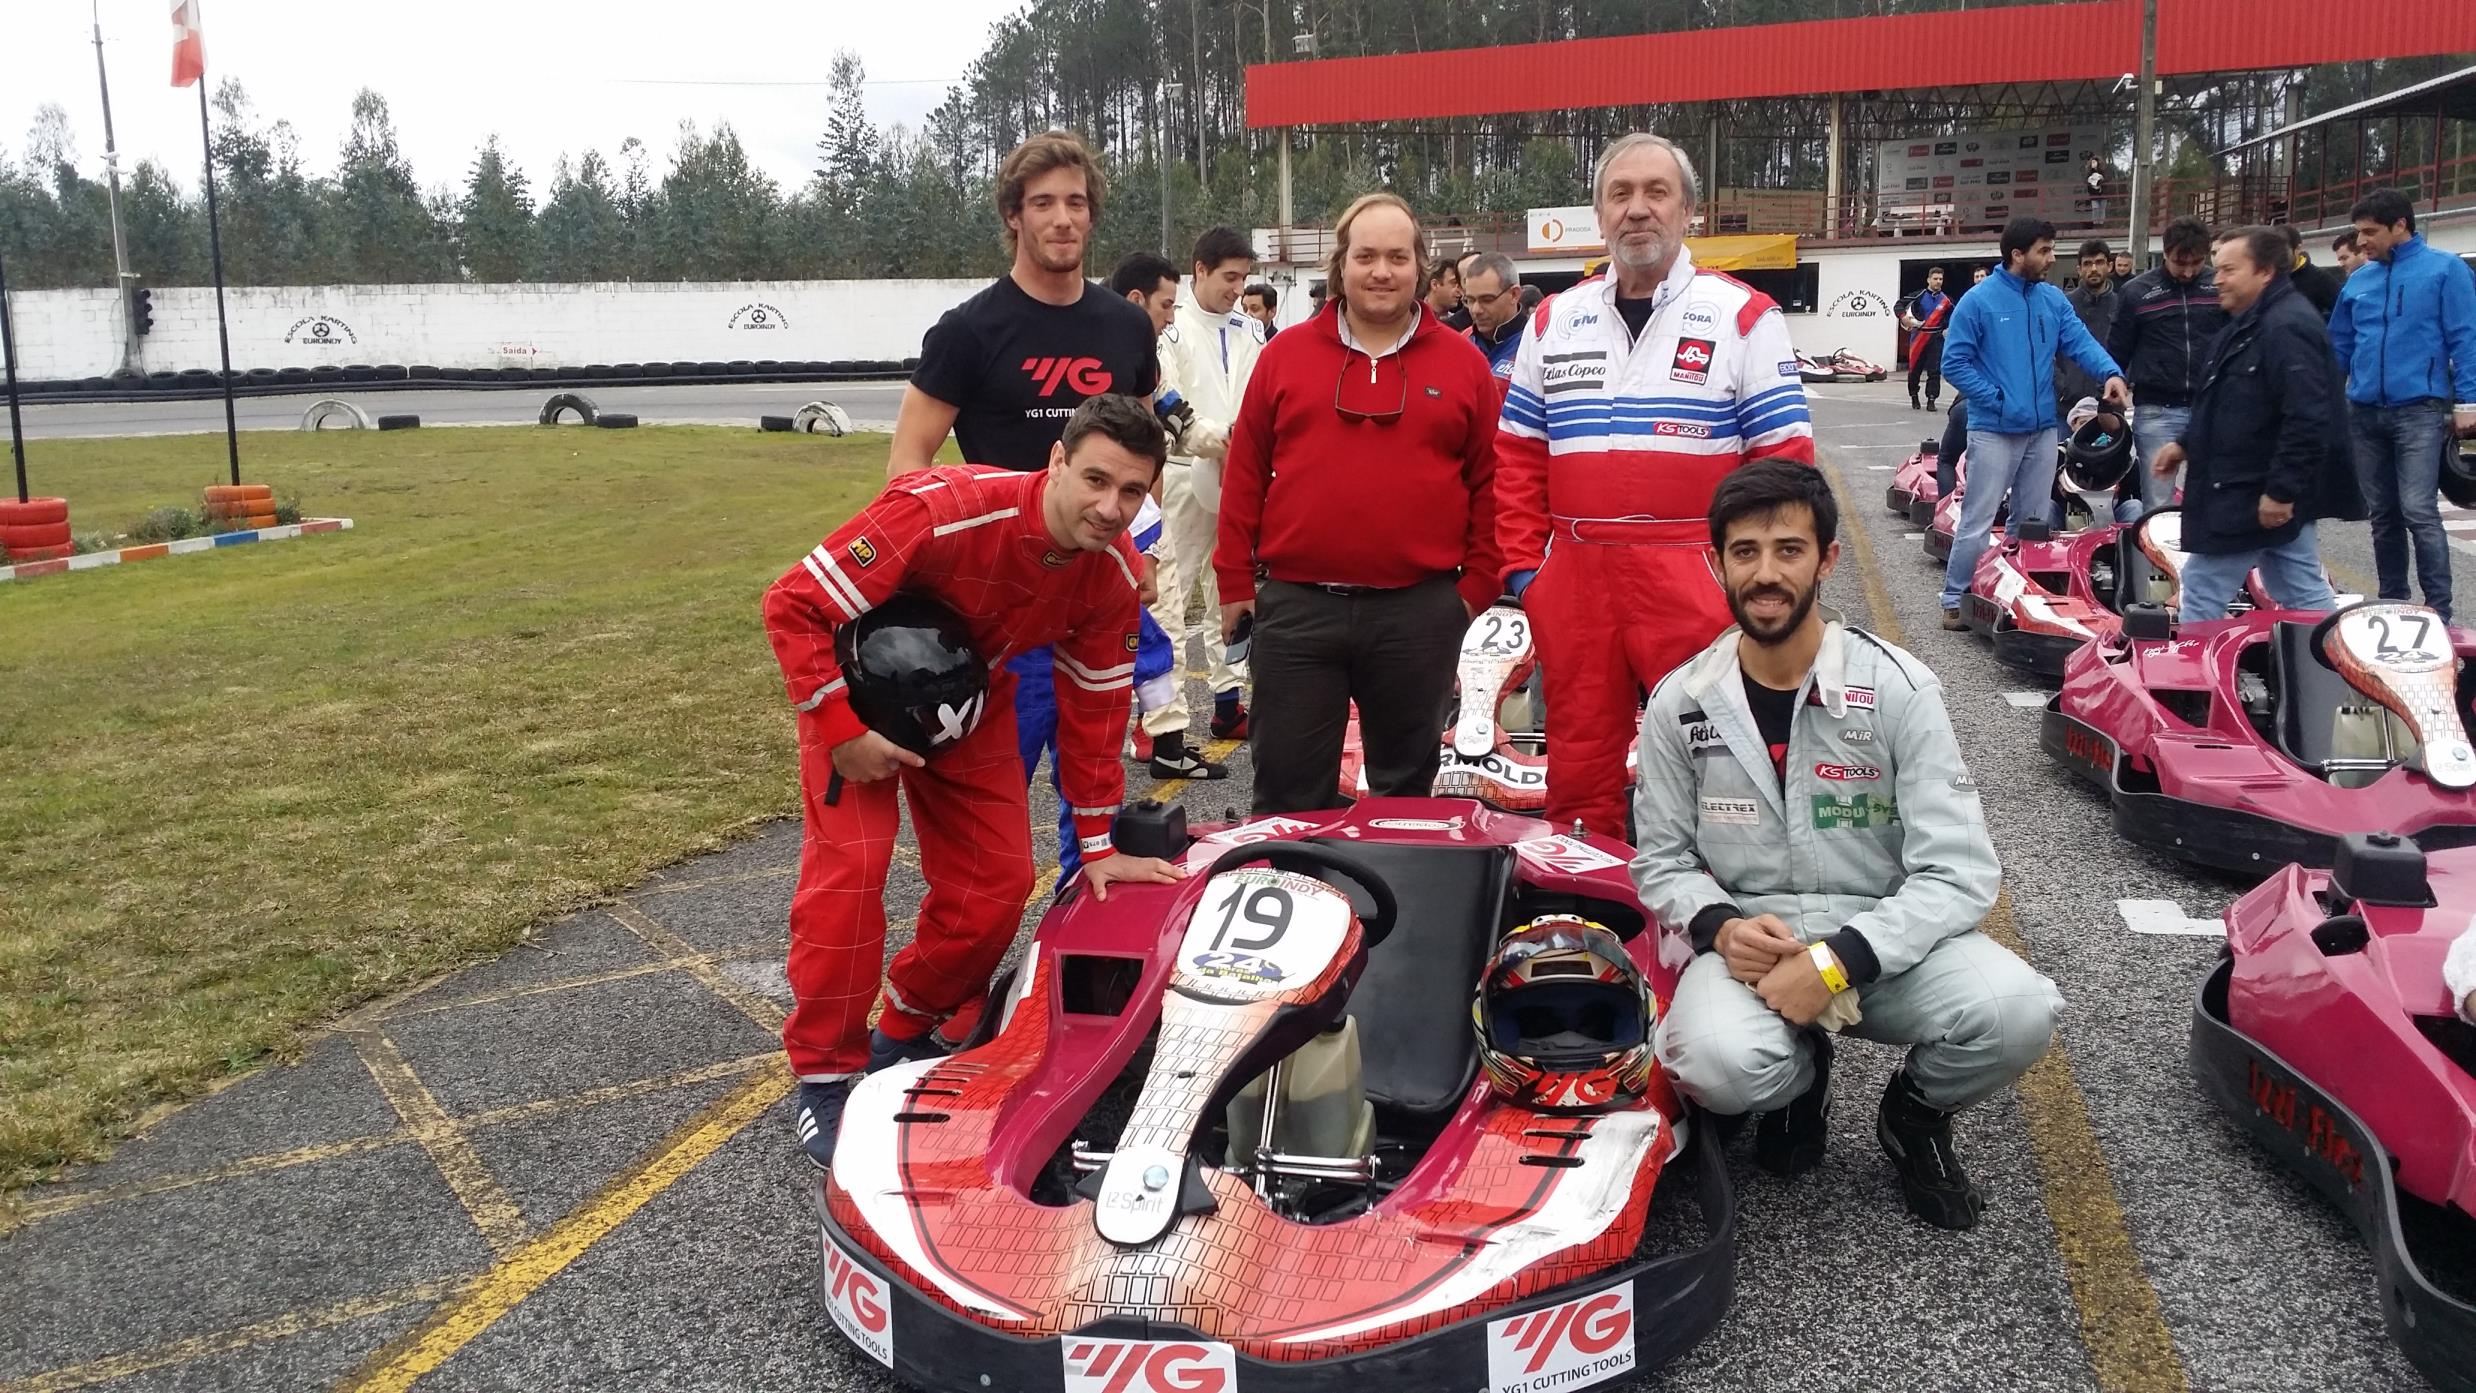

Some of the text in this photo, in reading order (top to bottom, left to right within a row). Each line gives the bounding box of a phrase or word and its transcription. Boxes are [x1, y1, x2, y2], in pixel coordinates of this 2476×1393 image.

[728, 303, 789, 329] ESCOLA KARTING
[1826, 290, 1891, 318] ESCOLA KARTING
[284, 315, 358, 344] ESCOLA KARTING
[1568, 363, 1607, 379] Copco
[1025, 408, 1079, 418] YG1 CUTTIN
[1657, 423, 1707, 436] KS TOOLS
[851, 539, 873, 559] MP
[1481, 616, 1525, 649] 23
[2368, 615, 2430, 653] 27
[1845, 690, 1874, 704] NITOU
[1440, 753, 1543, 784] RMOLD
[1819, 765, 1877, 778] KS TOOLS
[1209, 882, 1294, 951] 19
[1121, 1192, 1164, 1215] Spirit
[834, 1305, 861, 1340] CUTTING
[861, 1332, 888, 1360] TOOLS
[1501, 1294, 1632, 1375] YG
[1501, 1350, 1632, 1393] YG1 CUTTING TOOLS
